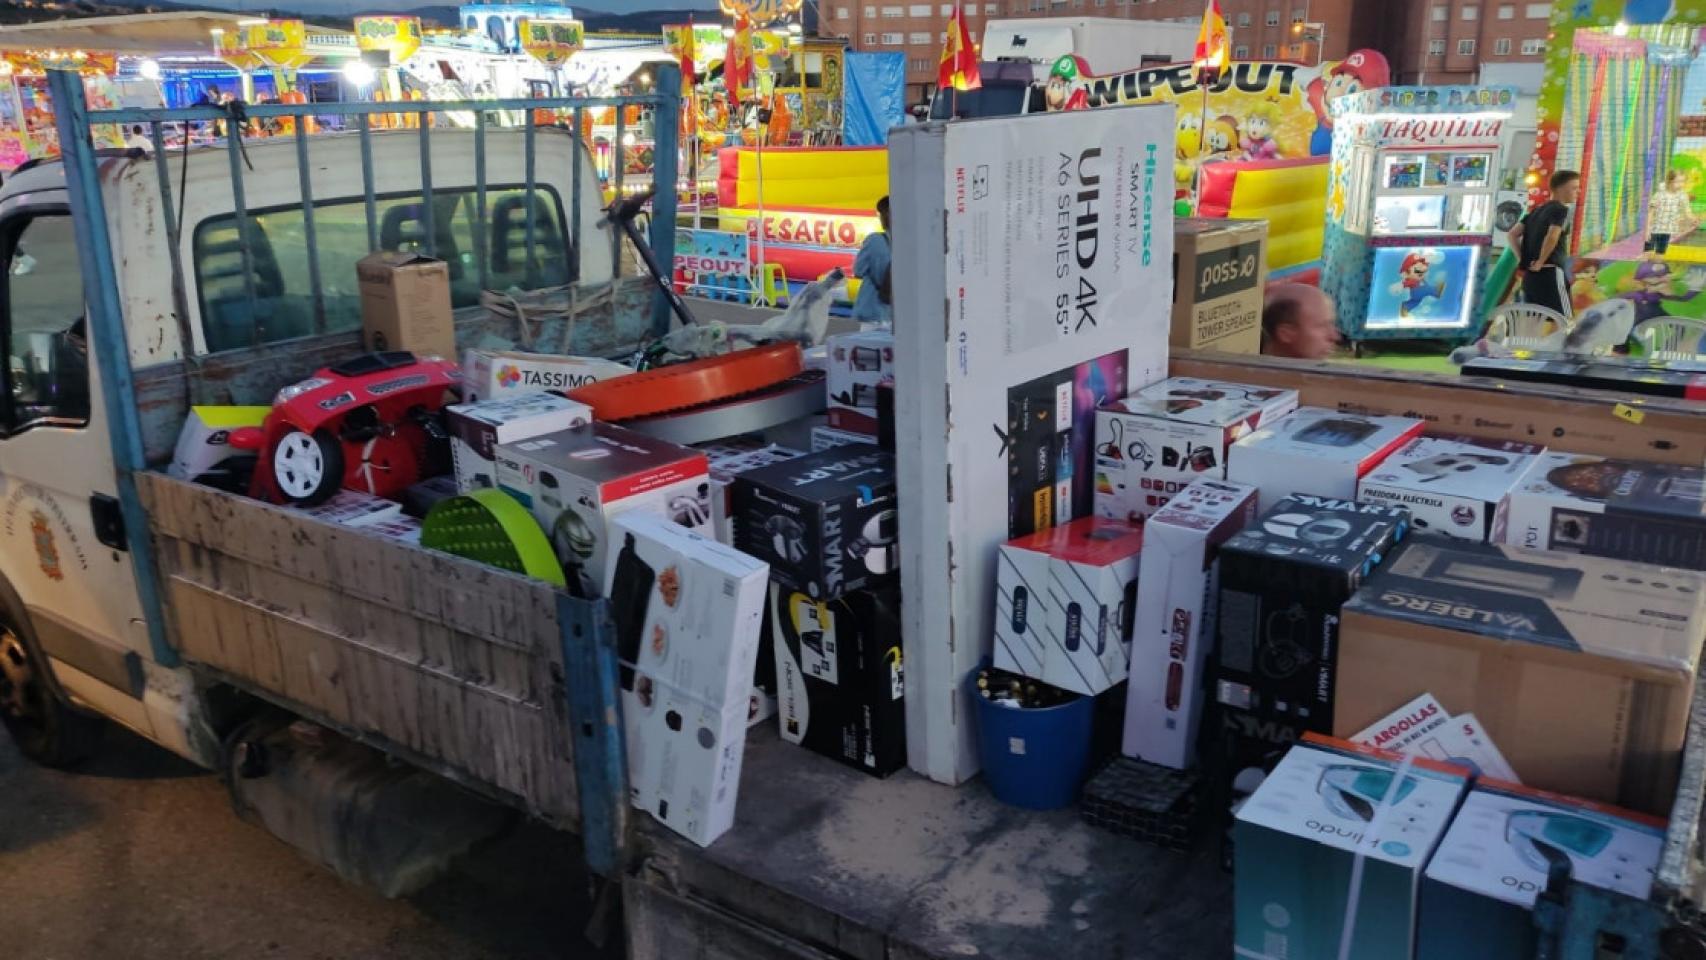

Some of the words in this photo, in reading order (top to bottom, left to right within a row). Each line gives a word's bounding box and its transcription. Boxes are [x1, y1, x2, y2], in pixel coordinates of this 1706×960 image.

[1380, 90, 1439, 106] SUPER
[1448, 89, 1512, 106] MARIO
[1382, 119, 1503, 142] TAQUILLA
[956, 167, 966, 214] NETFLIX
[1057, 152, 1073, 187] A6
[1075, 147, 1102, 270] UHD
[1129, 161, 1139, 228] SMART
[1142, 144, 1157, 267] Hisense
[747, 216, 857, 245] DESAFIO
[1056, 193, 1071, 279] SERIES
[673, 255, 745, 275] PEOUT
[1074, 275, 1098, 333] 4K
[1198, 320, 1224, 340] TOWER
[1224, 310, 1257, 331] SPEAKER
[520, 369, 598, 388] TASSIMO
[823, 502, 843, 600] SMART
[1380, 592, 1538, 632] VALBERG
[1373, 702, 1439, 747] ARGOLLAS
